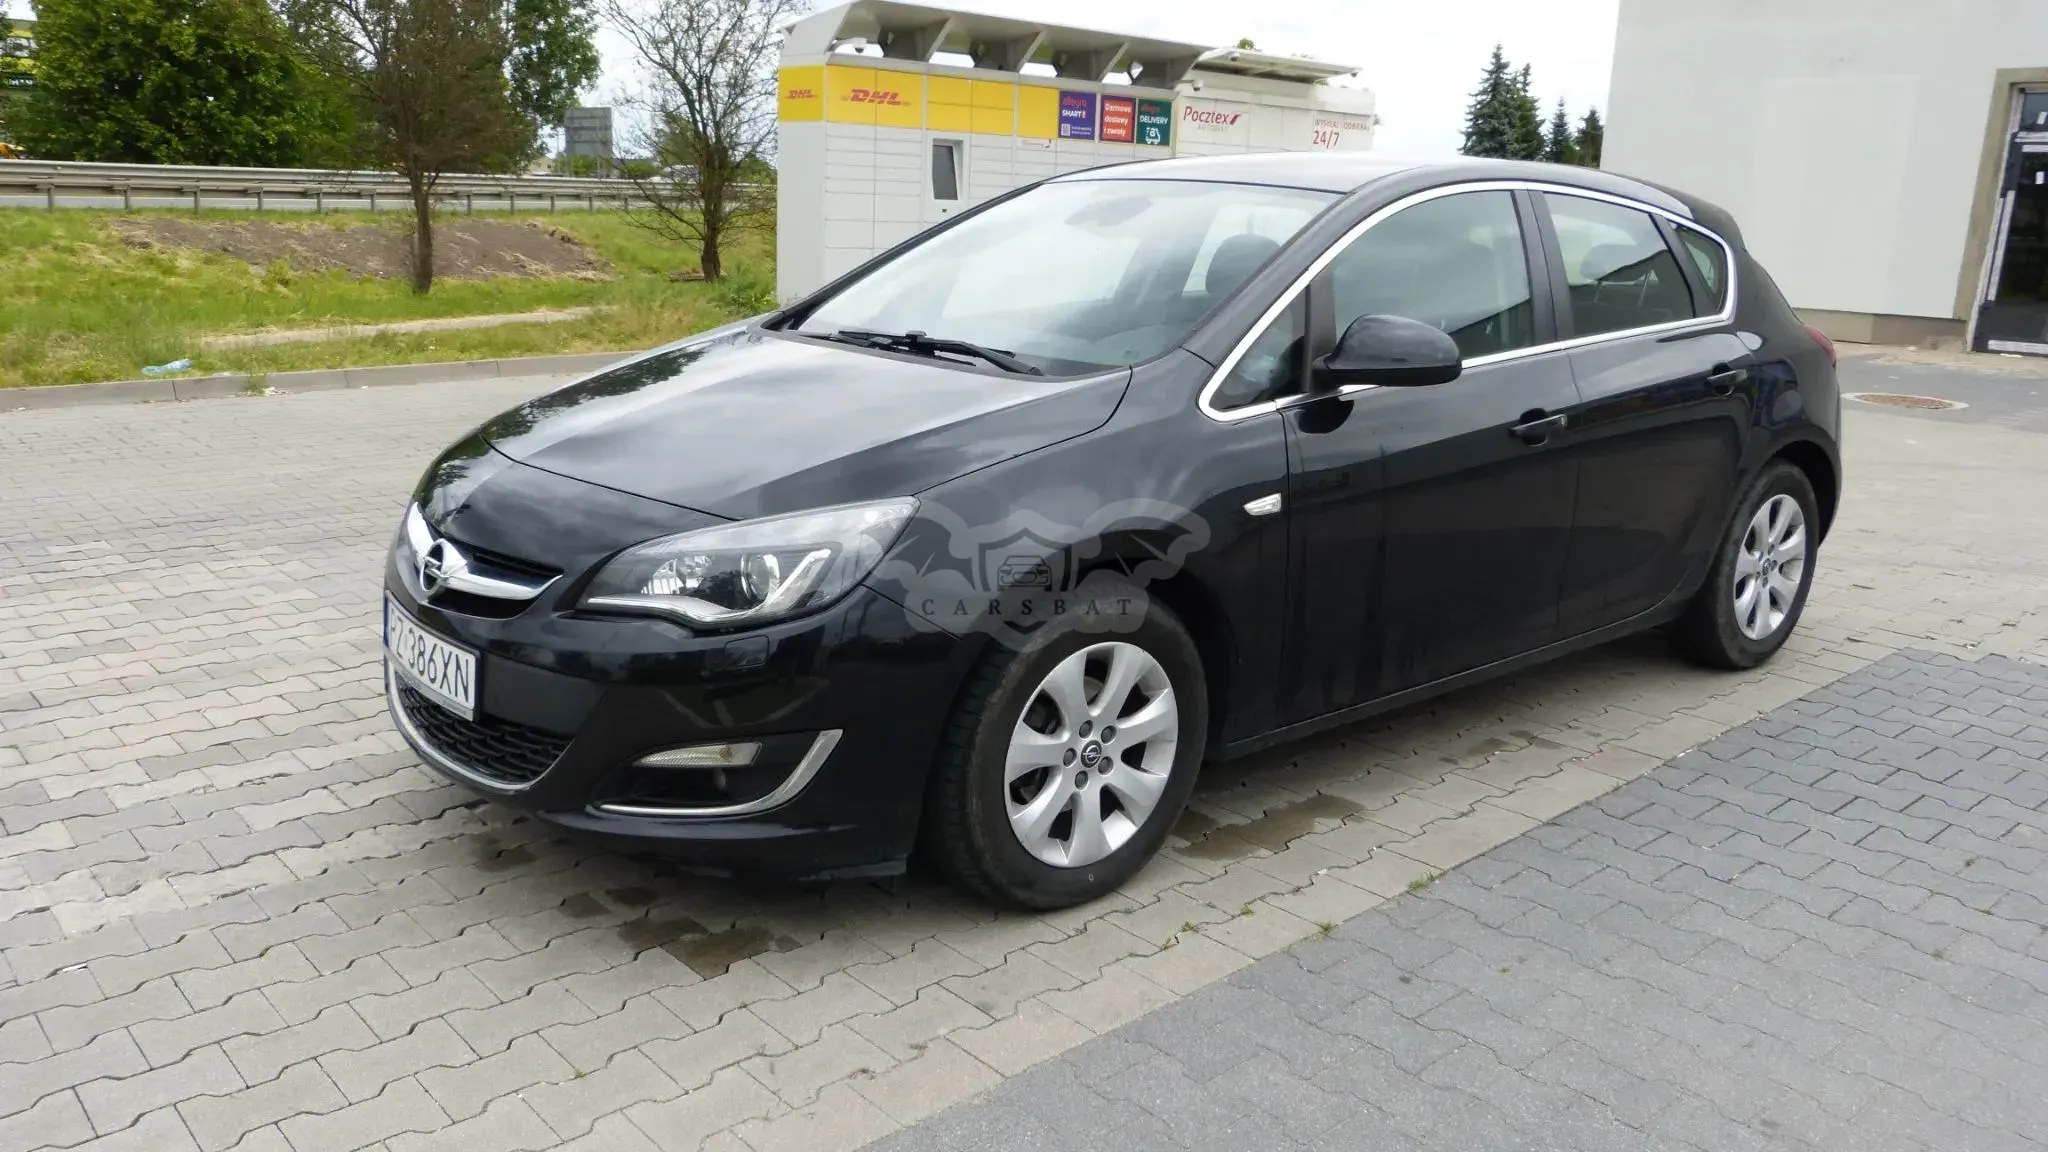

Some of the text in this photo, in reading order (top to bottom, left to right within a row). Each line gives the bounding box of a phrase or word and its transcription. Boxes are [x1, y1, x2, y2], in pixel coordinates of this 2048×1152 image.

[785, 89, 814, 99] DHL
[850, 88, 902, 106] DHL
[1104, 103, 1132, 113] Darmowe
[1104, 115, 1129, 125] dostawy
[1140, 115, 1168, 125] DELIVERY
[1183, 105, 1230, 125] Pocztex
[1107, 127, 1126, 137] zwroty
[1312, 130, 1340, 149] 24/7
[408, 627, 469, 704] 386XN
